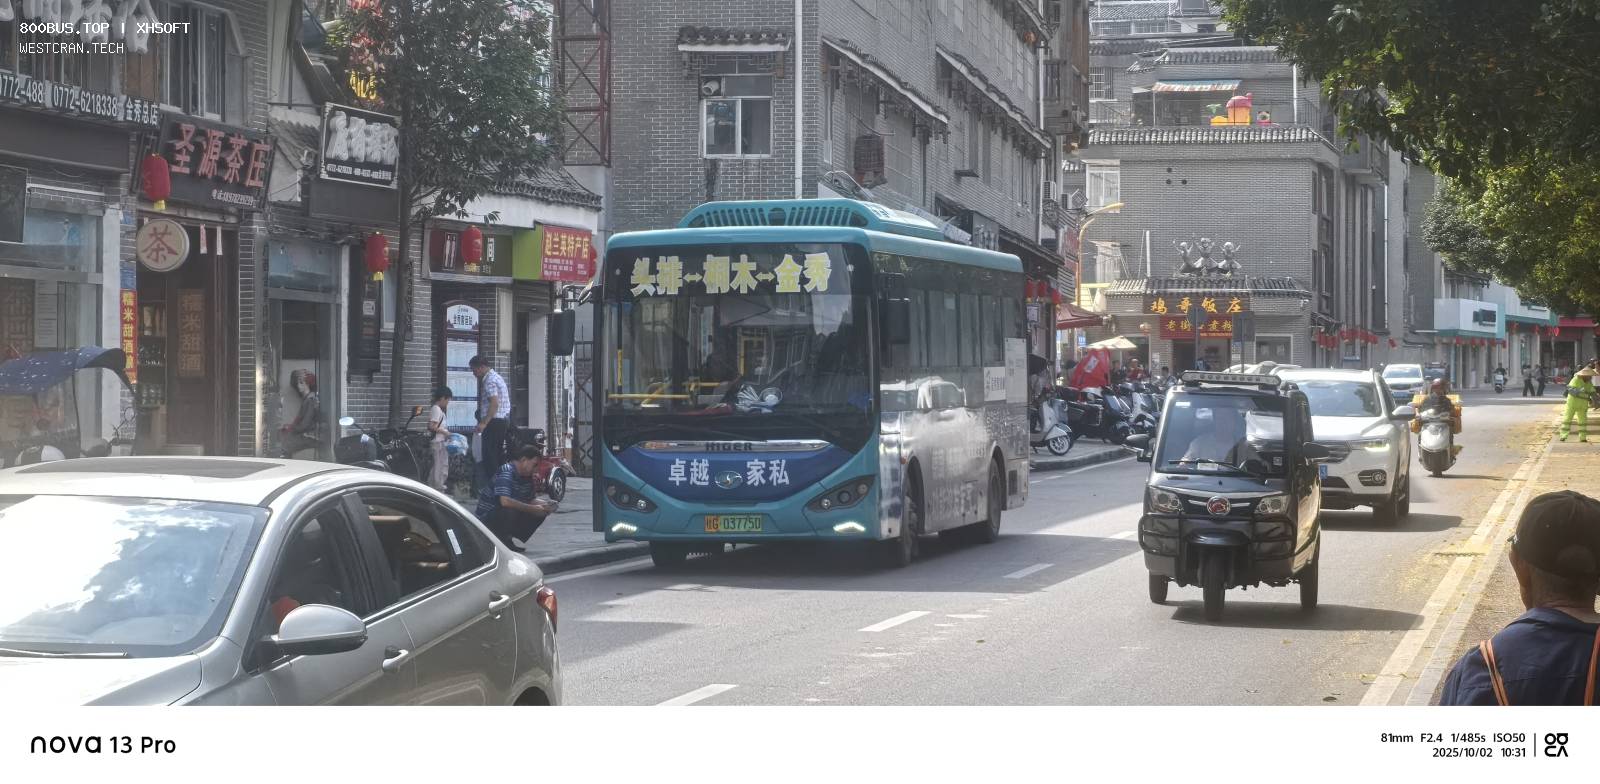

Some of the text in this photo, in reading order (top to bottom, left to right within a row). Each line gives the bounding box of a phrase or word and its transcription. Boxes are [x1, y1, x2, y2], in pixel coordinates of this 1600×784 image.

[53, 86, 118, 117] 0772-6218338
[126, 97, 159, 126] 金秀总店
[171, 123, 271, 187] 圣源茶庄
[144, 225, 178, 263] 茶
[630, 252, 833, 297] 头排 桐木 金秀
[1150, 296, 1243, 315] 鸡哥饭庄
[1165, 319, 1233, 332] 老街煮粉
[705, 441, 752, 451] HIGER
[668, 458, 790, 486] 卓越 家私
[723, 516, 761, 530] 037750
